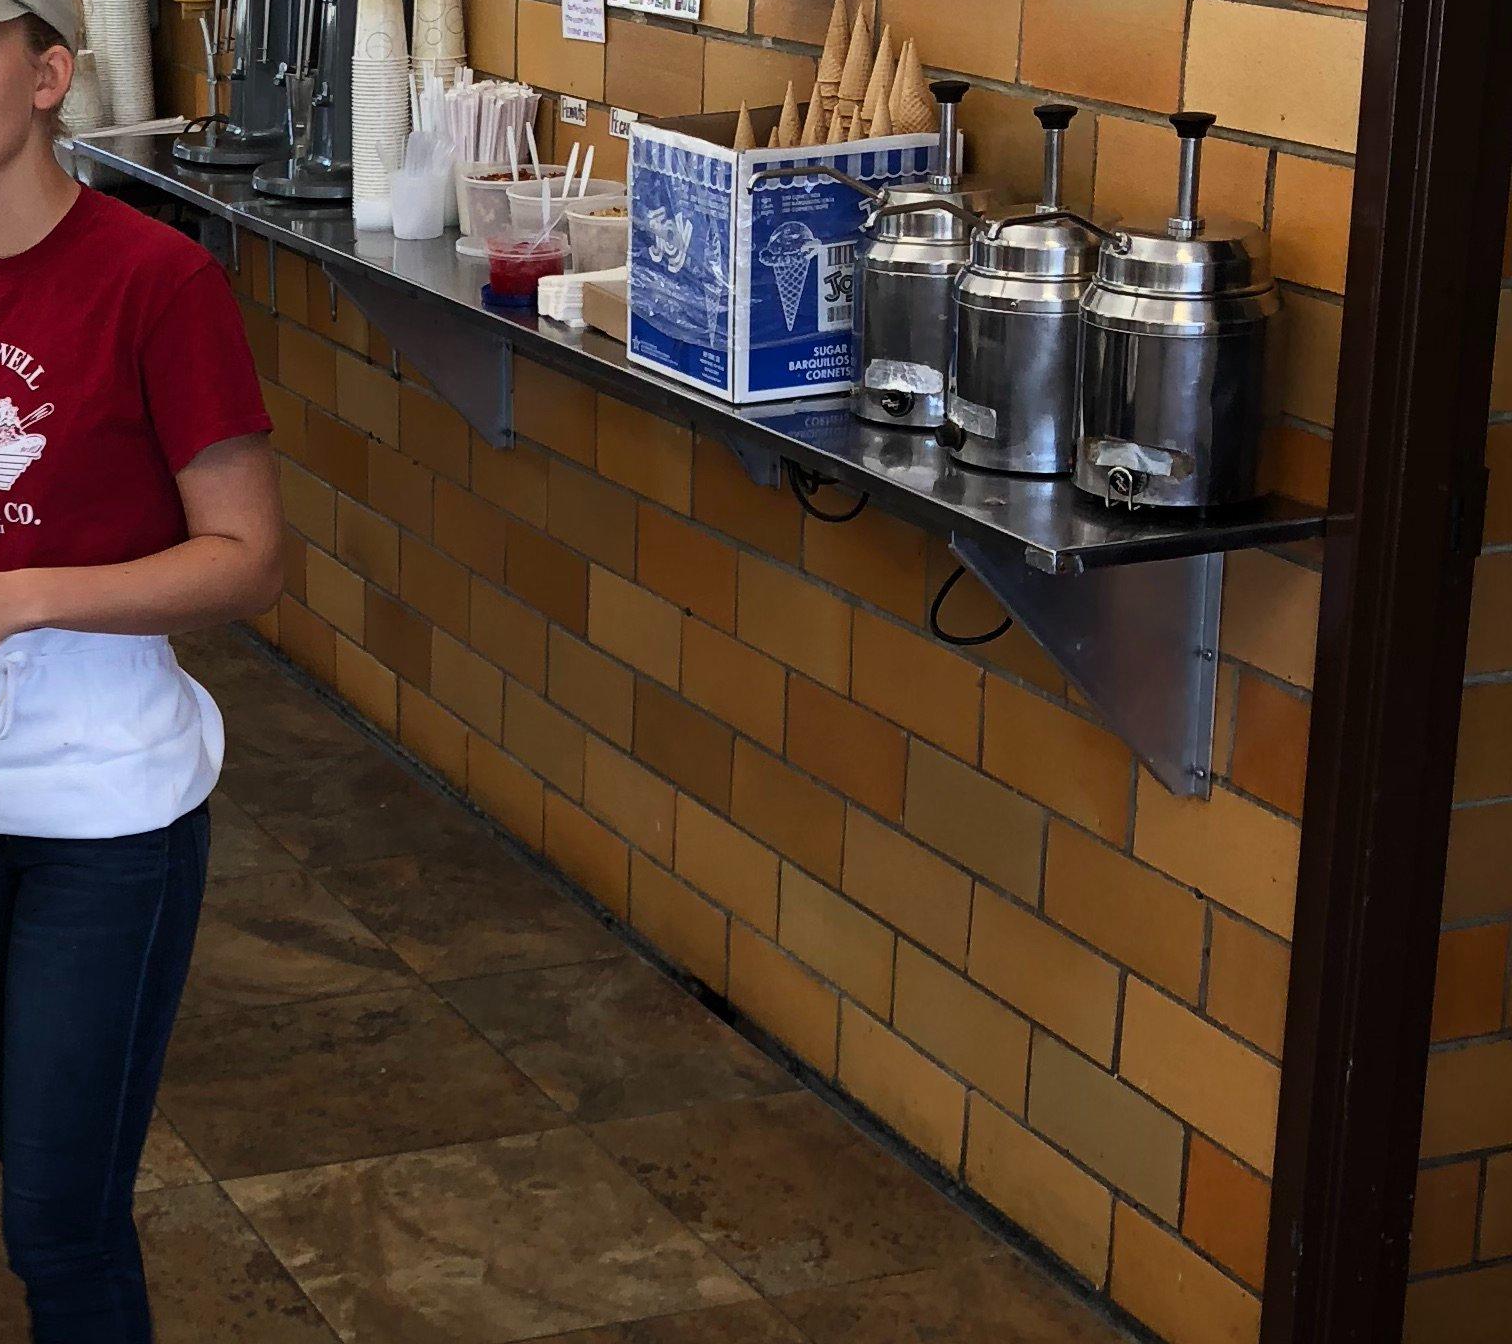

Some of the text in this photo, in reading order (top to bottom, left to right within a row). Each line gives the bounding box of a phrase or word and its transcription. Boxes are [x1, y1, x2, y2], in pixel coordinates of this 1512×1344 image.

[814, 345, 847, 356] SUGAR
[788, 355, 849, 371] BARQUILLOS
[4, 502, 42, 526] CO.
